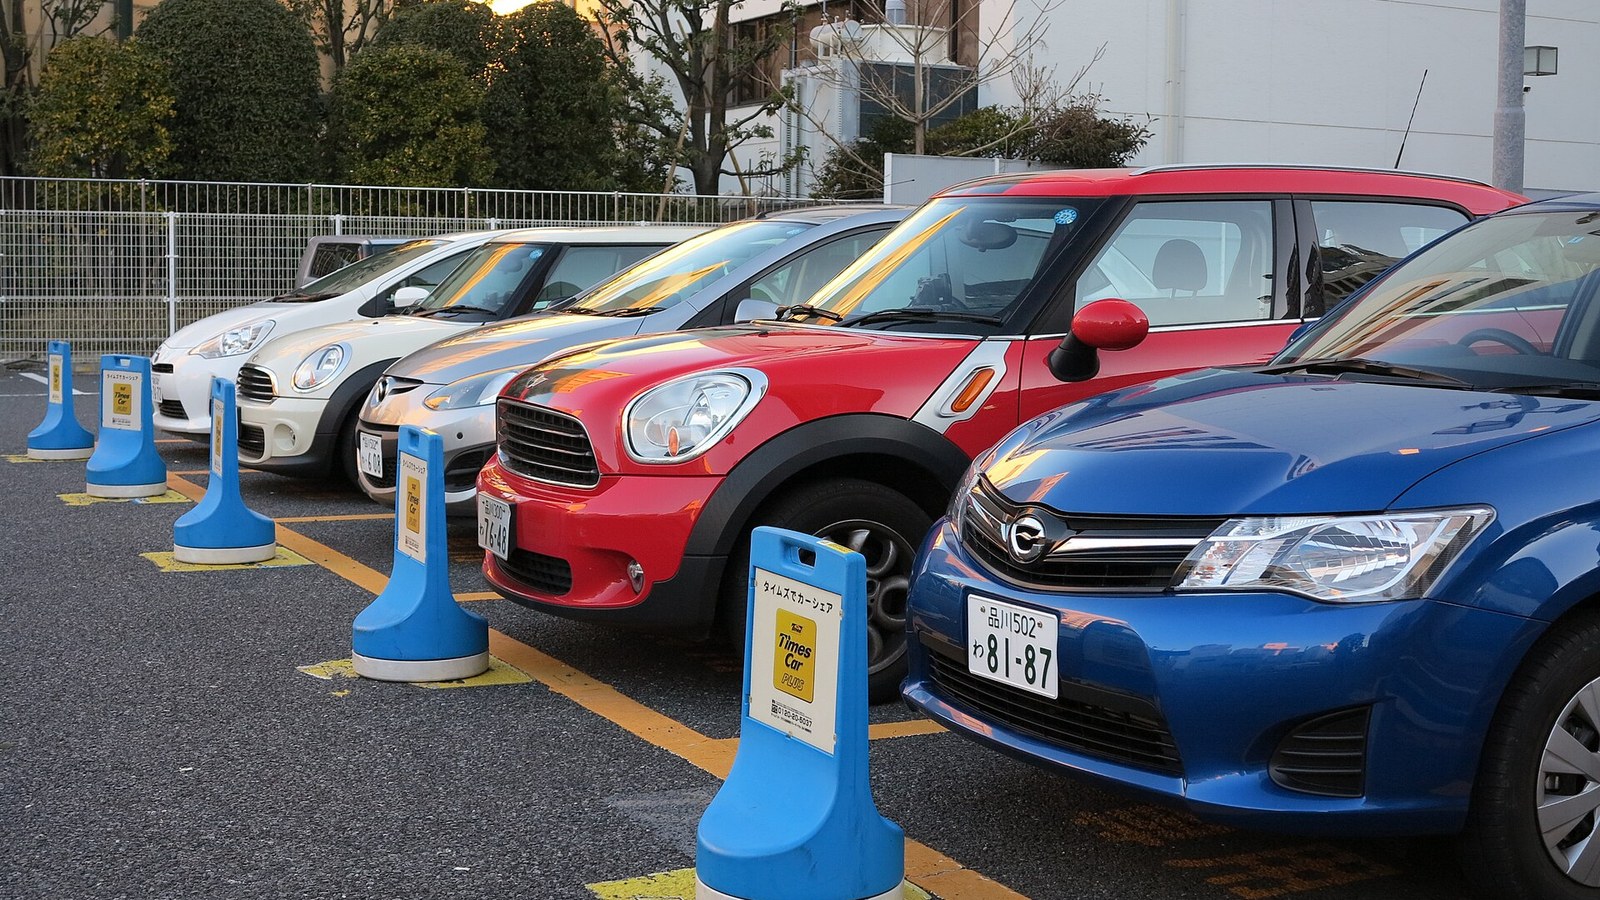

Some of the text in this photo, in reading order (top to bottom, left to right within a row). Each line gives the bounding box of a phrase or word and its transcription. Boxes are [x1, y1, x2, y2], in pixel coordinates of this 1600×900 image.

[484, 517, 507, 555] 76-48
[763, 581, 833, 614] タイムズでカーシェア
[988, 606, 1036, 638] 品川502
[778, 633, 812, 658] Times
[784, 653, 804, 671] Car
[973, 633, 1052, 689] わ 81-87
[781, 672, 805, 691] PLUS
[778, 706, 812, 728] 0120-20-5037
